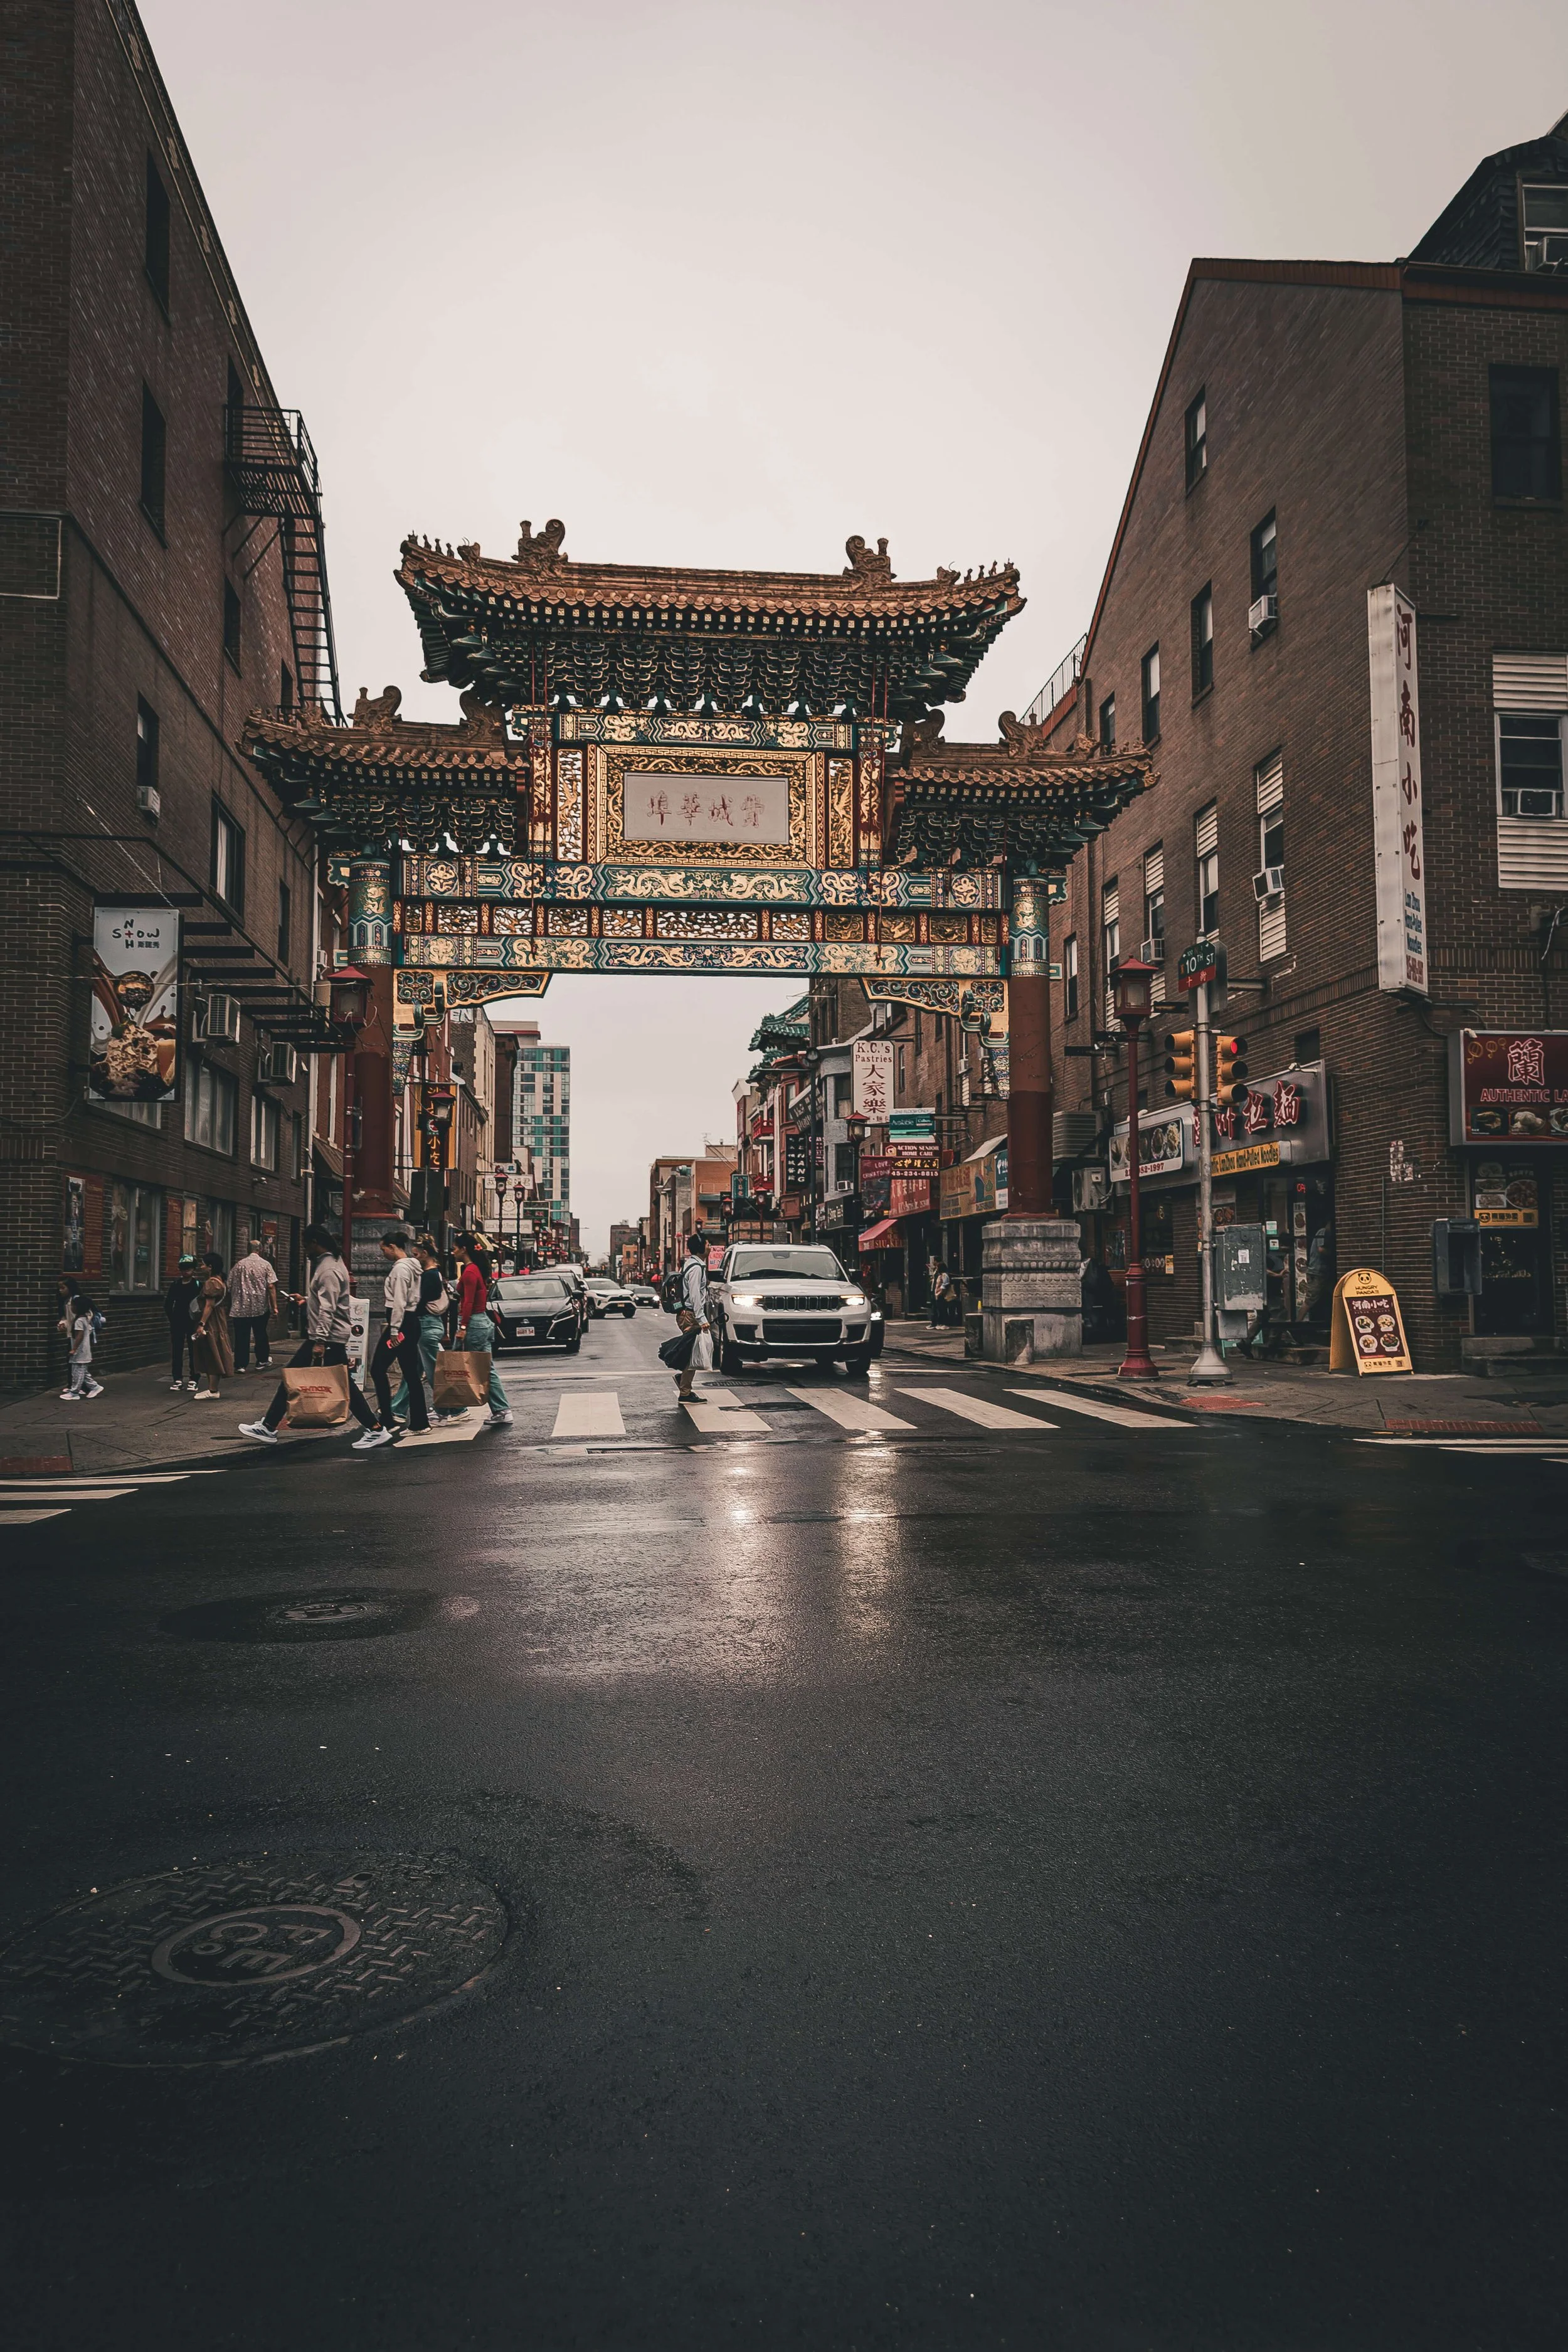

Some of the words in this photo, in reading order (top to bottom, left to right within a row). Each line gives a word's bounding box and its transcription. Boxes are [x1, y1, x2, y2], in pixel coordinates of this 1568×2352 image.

[1206, 953, 1214, 965] ST
[857, 1042, 891, 1054] K.C.'s
[855, 1054, 893, 1063] Pastries
[1507, 1038, 1545, 1086] 蘭
[862, 1064, 887, 1114] 大家樂
[1480, 1088, 1550, 1103] AUTHENTIC
[1261, 1143, 1279, 1165] Noodles
[891, 1158, 939, 1169] 心护理公司
[1125, 1162, 1165, 1177] 2152-1997
[1352, 1298, 1390, 1310] 河南小吃
